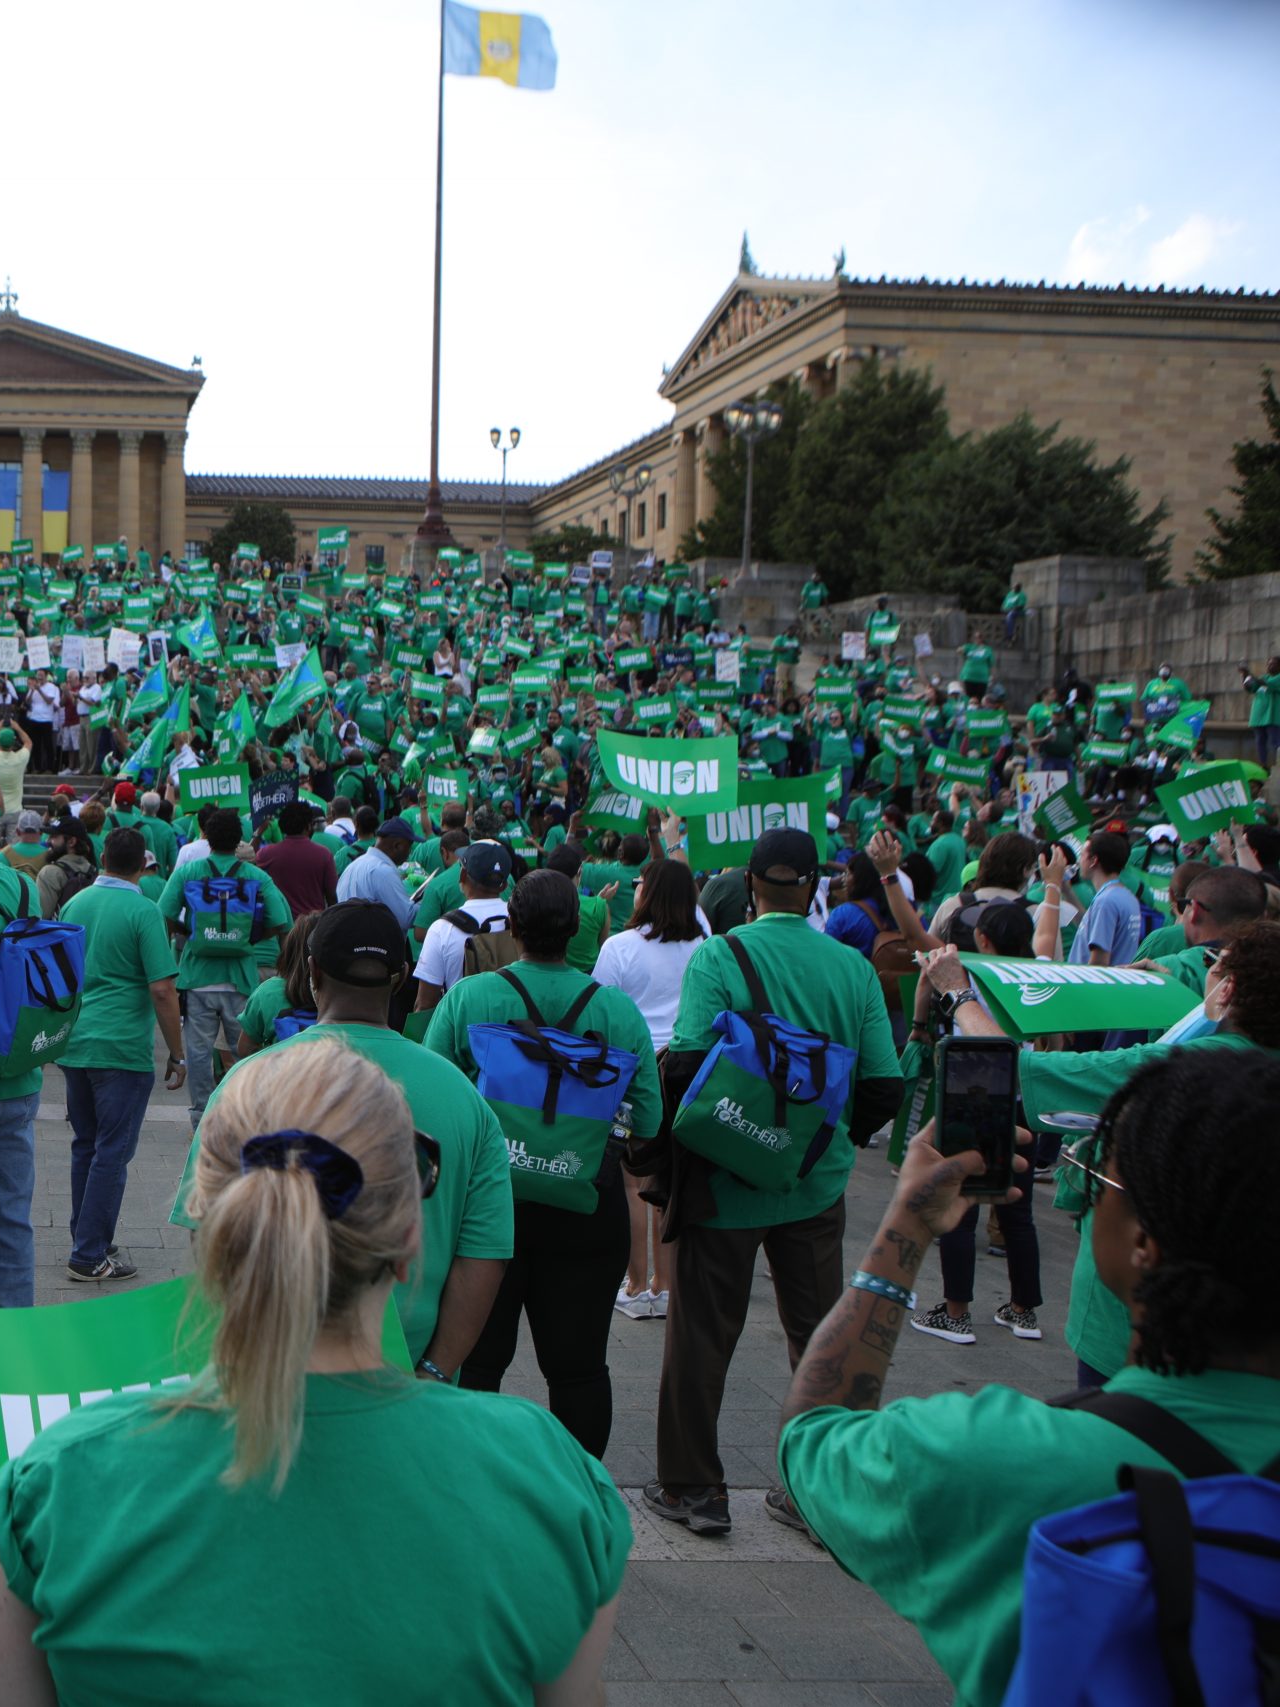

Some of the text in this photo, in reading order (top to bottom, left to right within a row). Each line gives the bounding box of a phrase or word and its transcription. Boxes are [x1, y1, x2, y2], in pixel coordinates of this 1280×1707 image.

[397, 651, 422, 664] UNION
[620, 652, 647, 667] UNION
[639, 702, 672, 718] UNION
[617, 753, 719, 795] UNION
[189, 775, 241, 798] UNION
[428, 774, 458, 798] VOTE
[1178, 779, 1248, 821] UNION
[706, 802, 809, 844] UNION
[204, 927, 218, 936] ALL
[206, 932, 238, 942] TOGETHER
[981, 961, 1166, 987] SOLIDARITY
[31, 1031, 65, 1053] TOGETHER
[32, 1030, 46, 1044] ALL
[716, 1096, 743, 1116] ALL
[713, 1105, 778, 1147] TOGETHER
[508, 1150, 569, 1176] OGETHER
